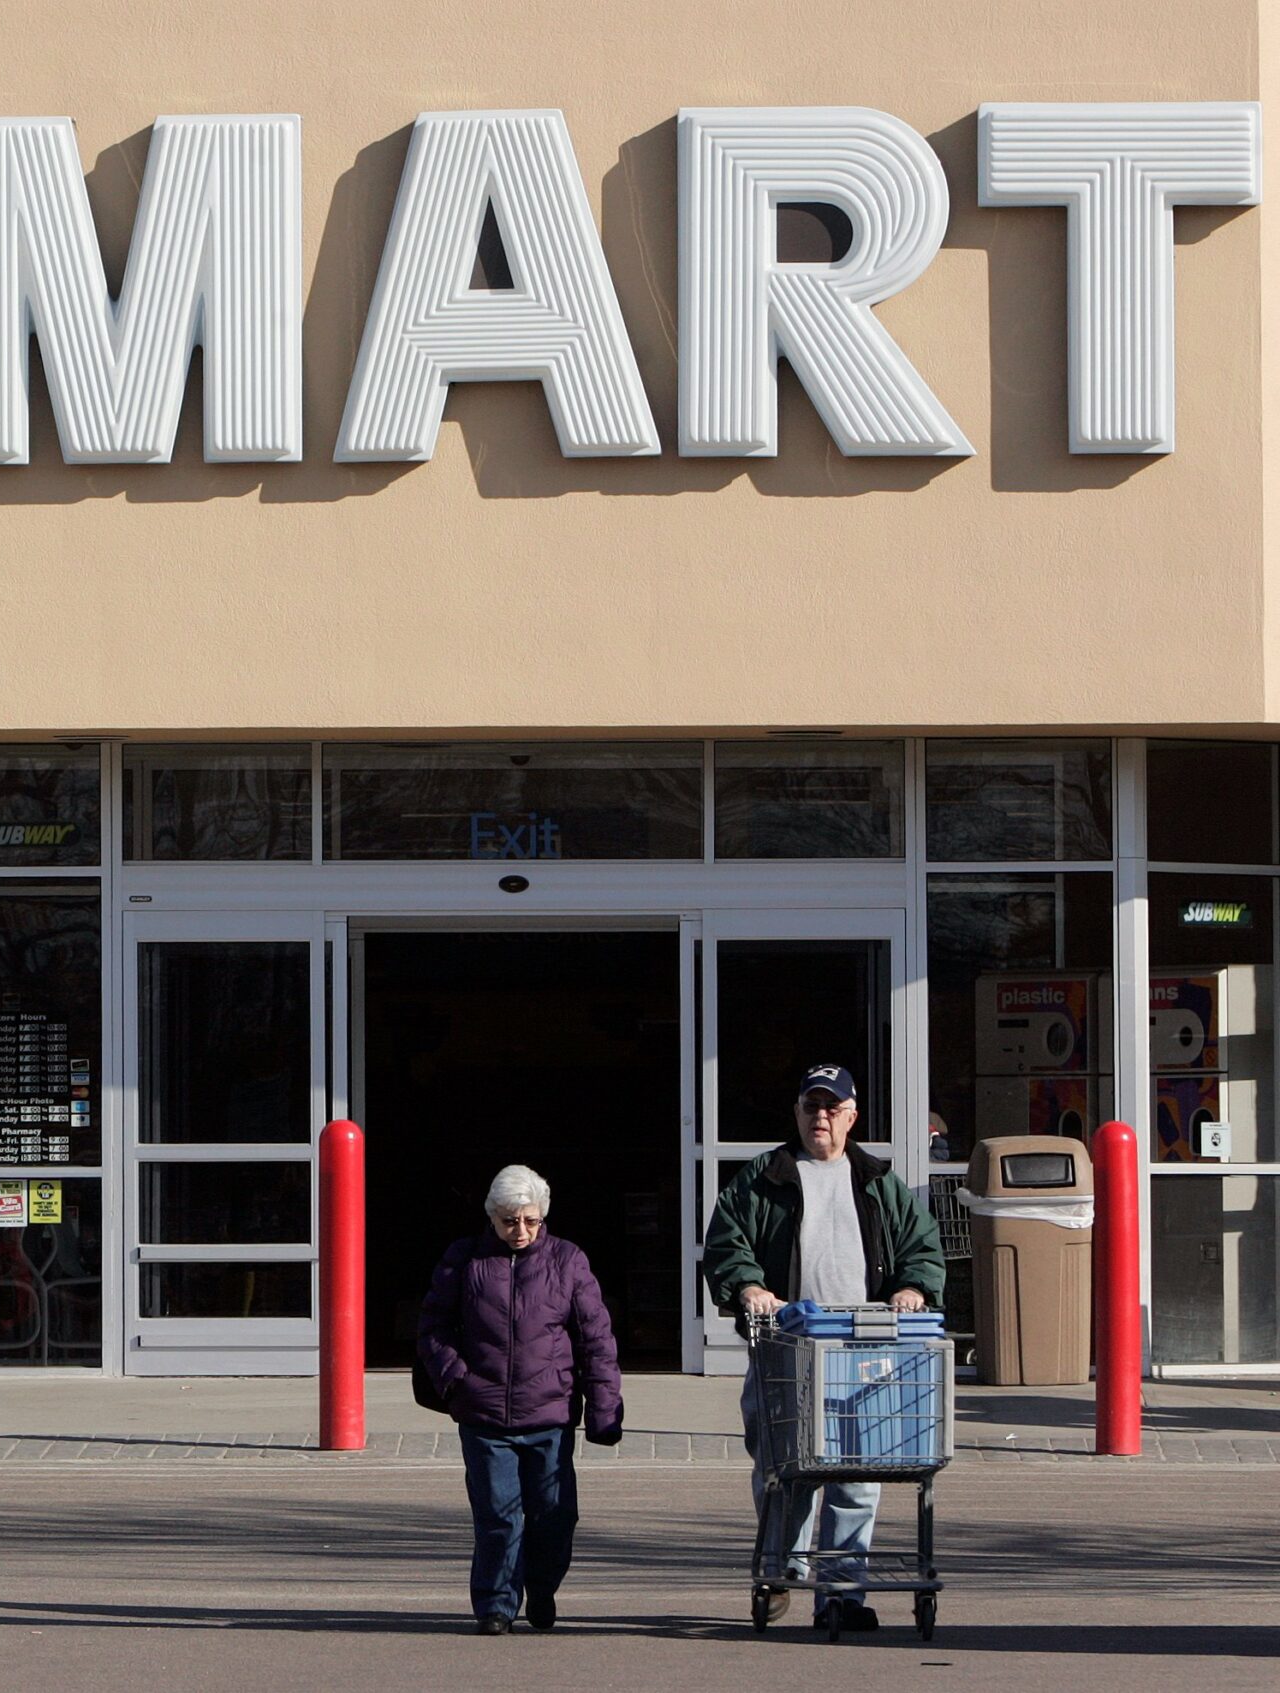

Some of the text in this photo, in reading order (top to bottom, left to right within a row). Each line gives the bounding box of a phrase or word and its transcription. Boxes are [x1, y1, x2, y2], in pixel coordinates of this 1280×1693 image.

[471, 812, 560, 859] Exit
[1184, 902, 1246, 922] SUBWAY
[1002, 987, 1065, 1008] plastic
[20, 1013, 48, 1021] Hours
[30, 1097, 54, 1105] Photo
[1, 1128, 42, 1136] Pharmacy
